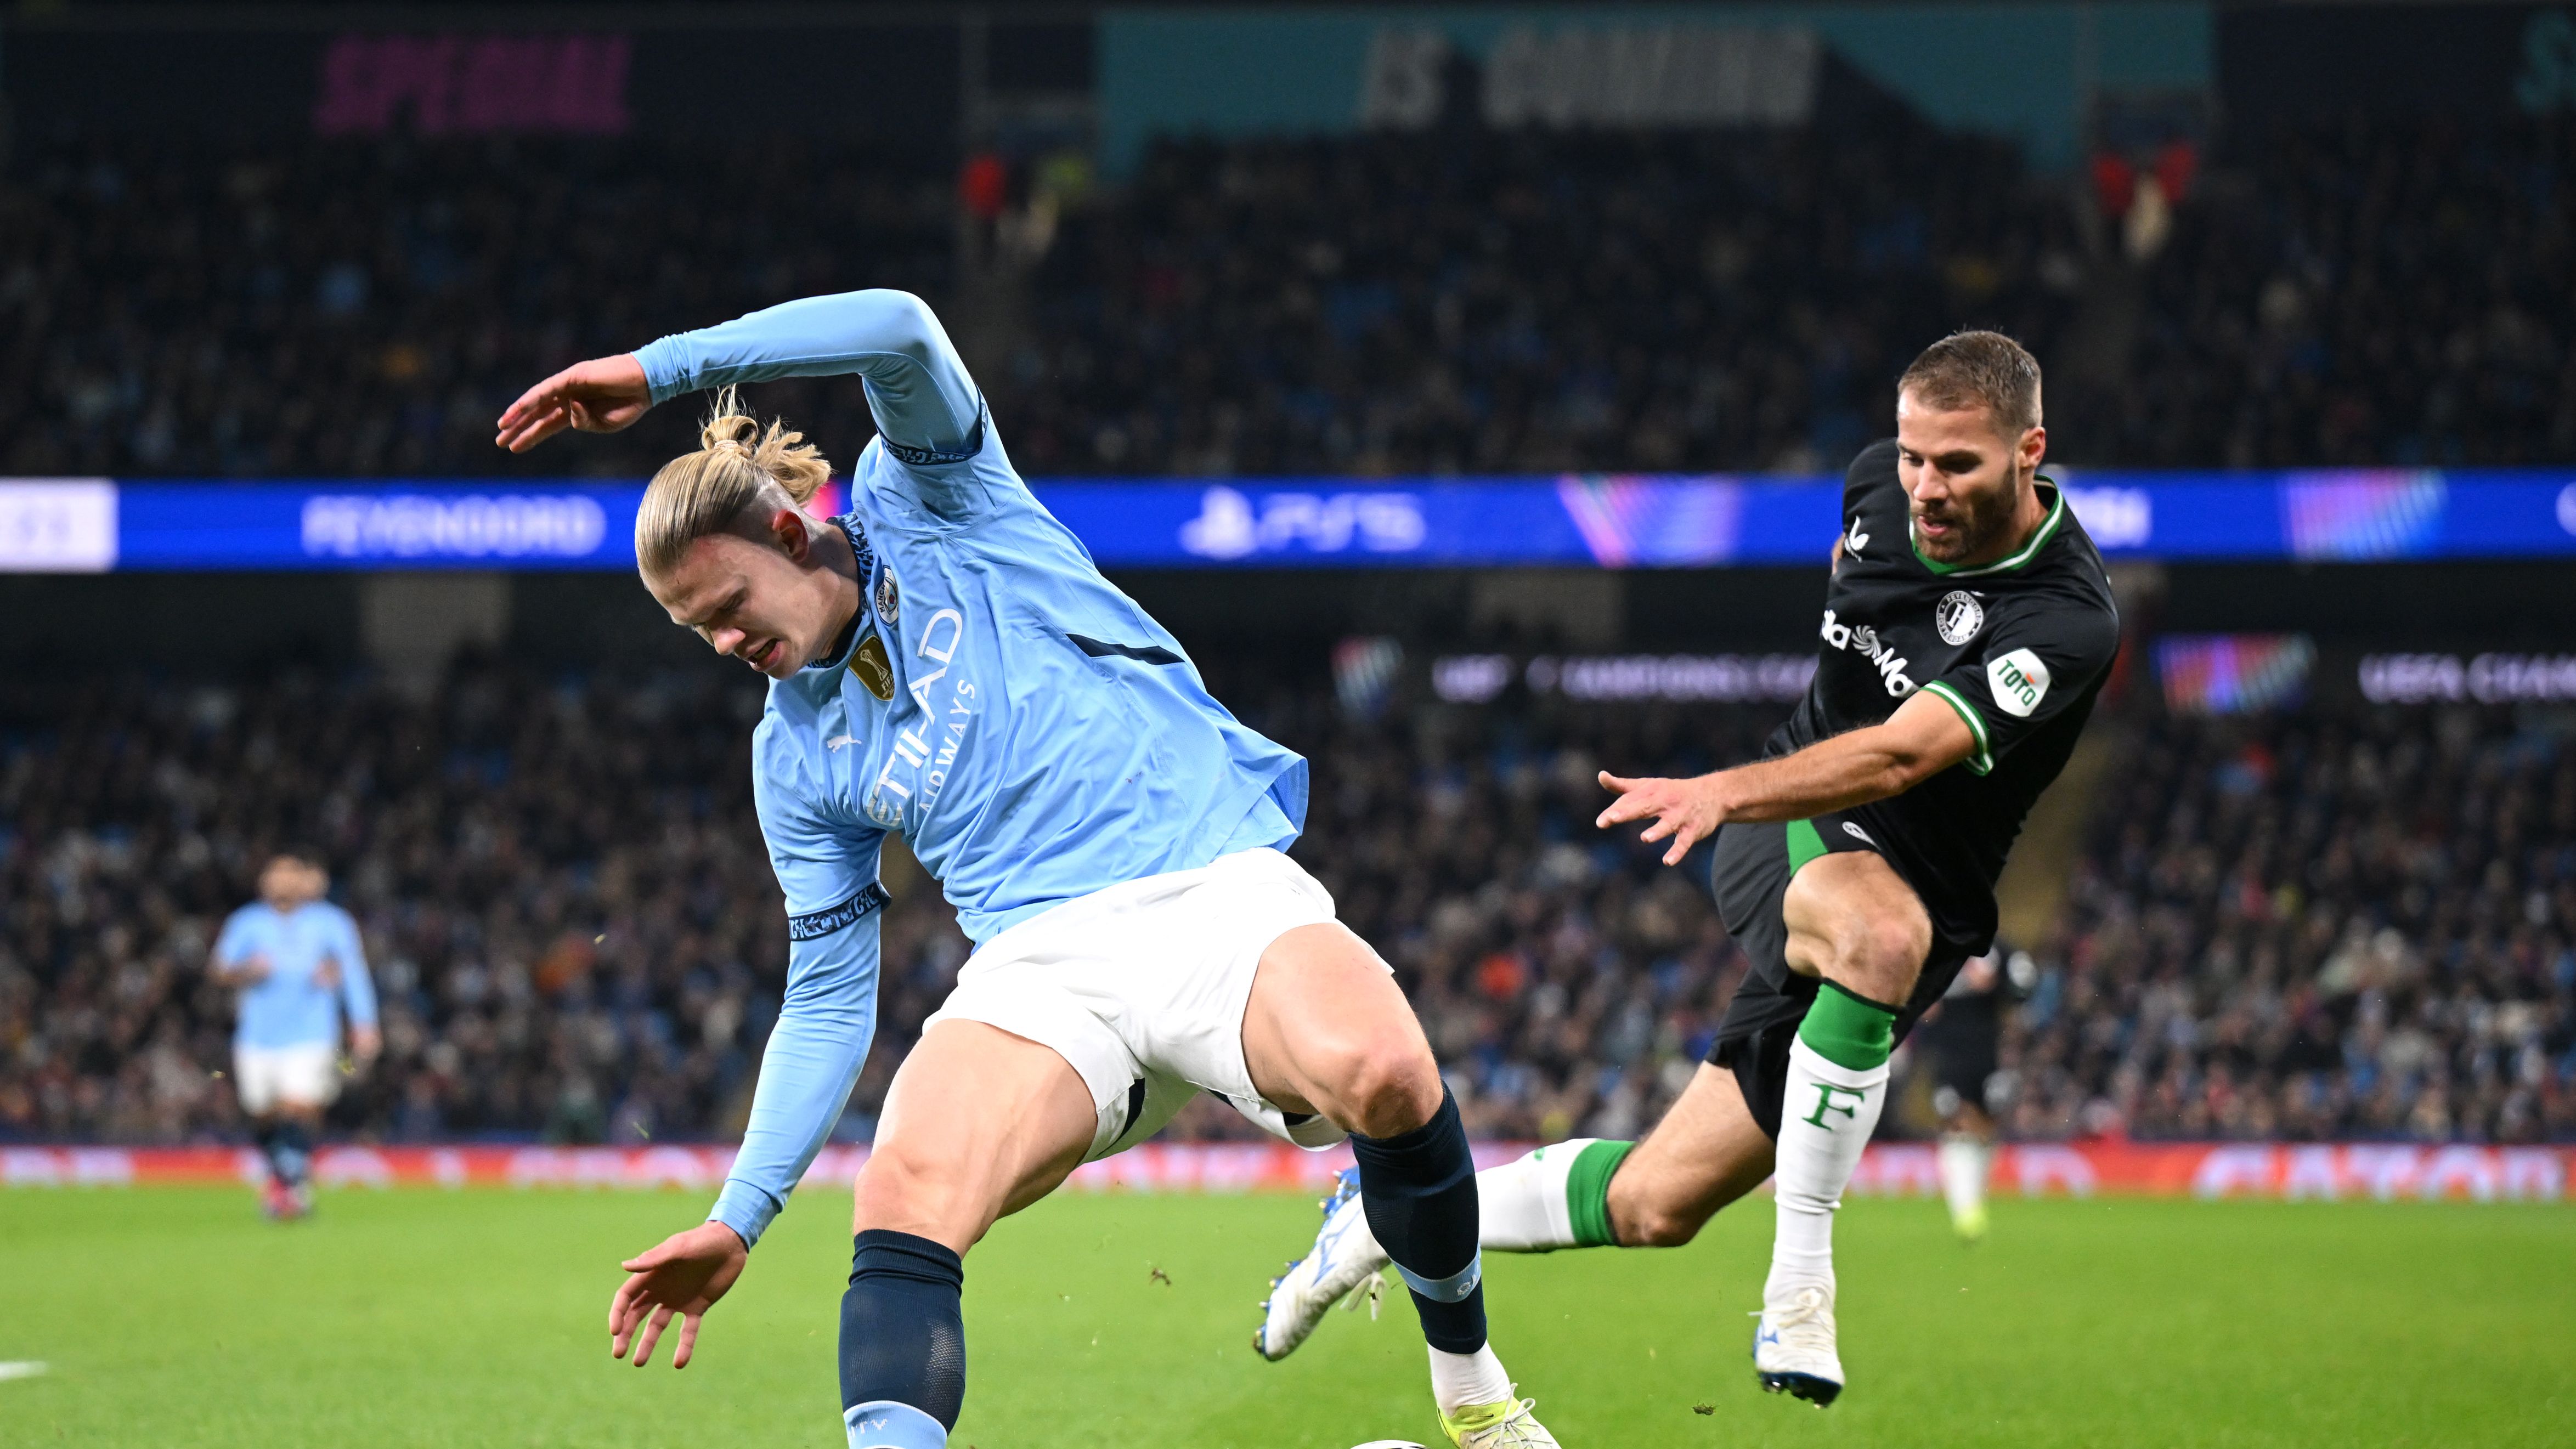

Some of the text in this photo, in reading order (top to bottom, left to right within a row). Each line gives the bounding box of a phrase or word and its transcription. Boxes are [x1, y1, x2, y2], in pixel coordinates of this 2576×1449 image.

[301, 495, 606, 555] FEYENOORD
[1259, 493, 1426, 551] PS5
[1874, 647, 1919, 698] Ma
[1997, 659, 2036, 706] TOTO
[2359, 653, 2466, 704] UEFA
[1801, 1083, 1865, 1131] F
